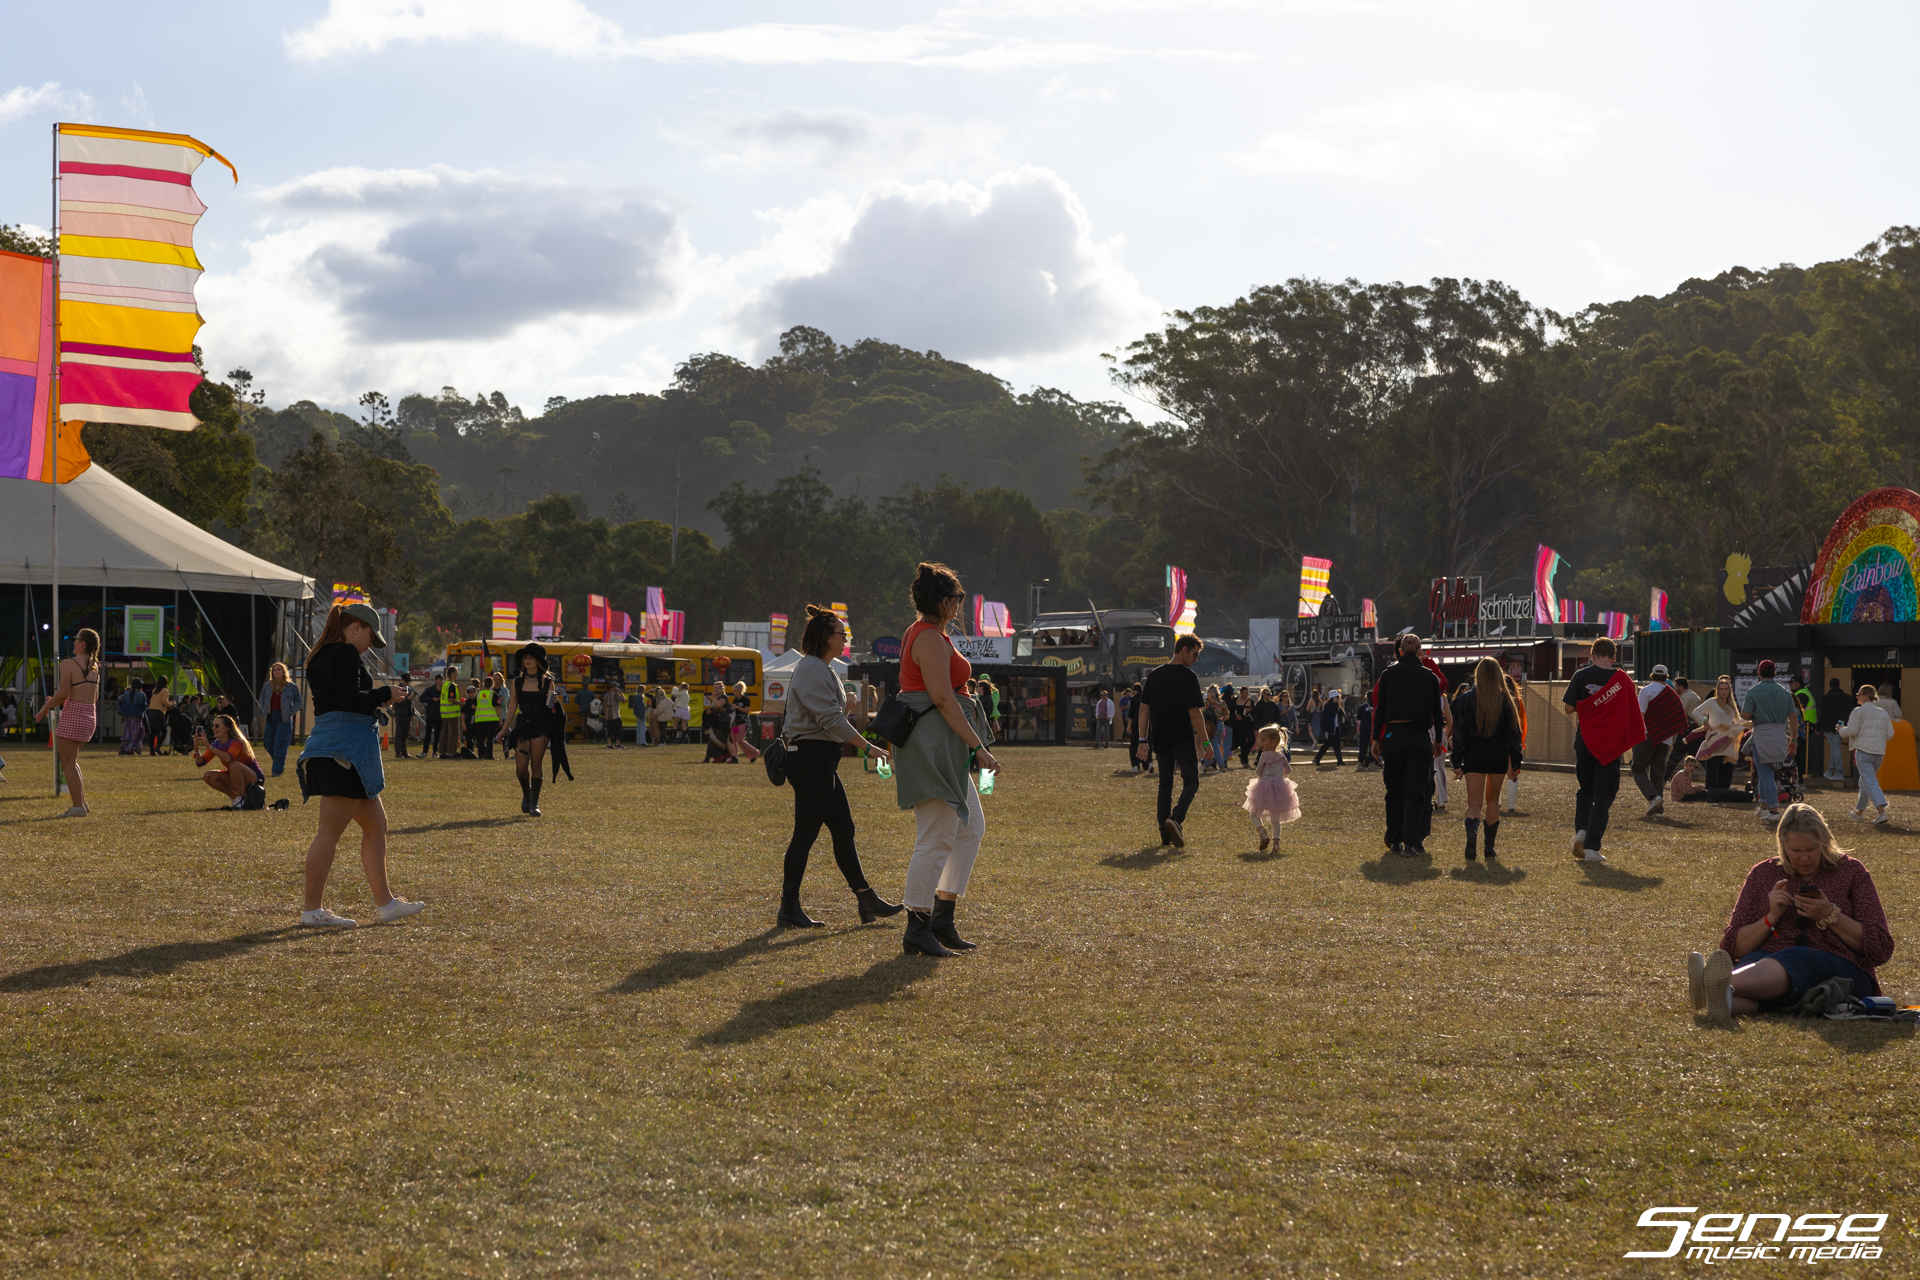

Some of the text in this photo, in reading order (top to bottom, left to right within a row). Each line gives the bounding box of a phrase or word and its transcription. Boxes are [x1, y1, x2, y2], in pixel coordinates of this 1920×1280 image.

[1810, 574, 1835, 614] The
[1840, 552, 1906, 599] Rainbow
[1428, 577, 1536, 640] Rolling schnitzel
[1335, 615, 1359, 624] GOURMET
[1300, 626, 1359, 645] GÖZLEME
[1801, 657, 1813, 665] ENTRY
[1887, 650, 1897, 660] EXIT
